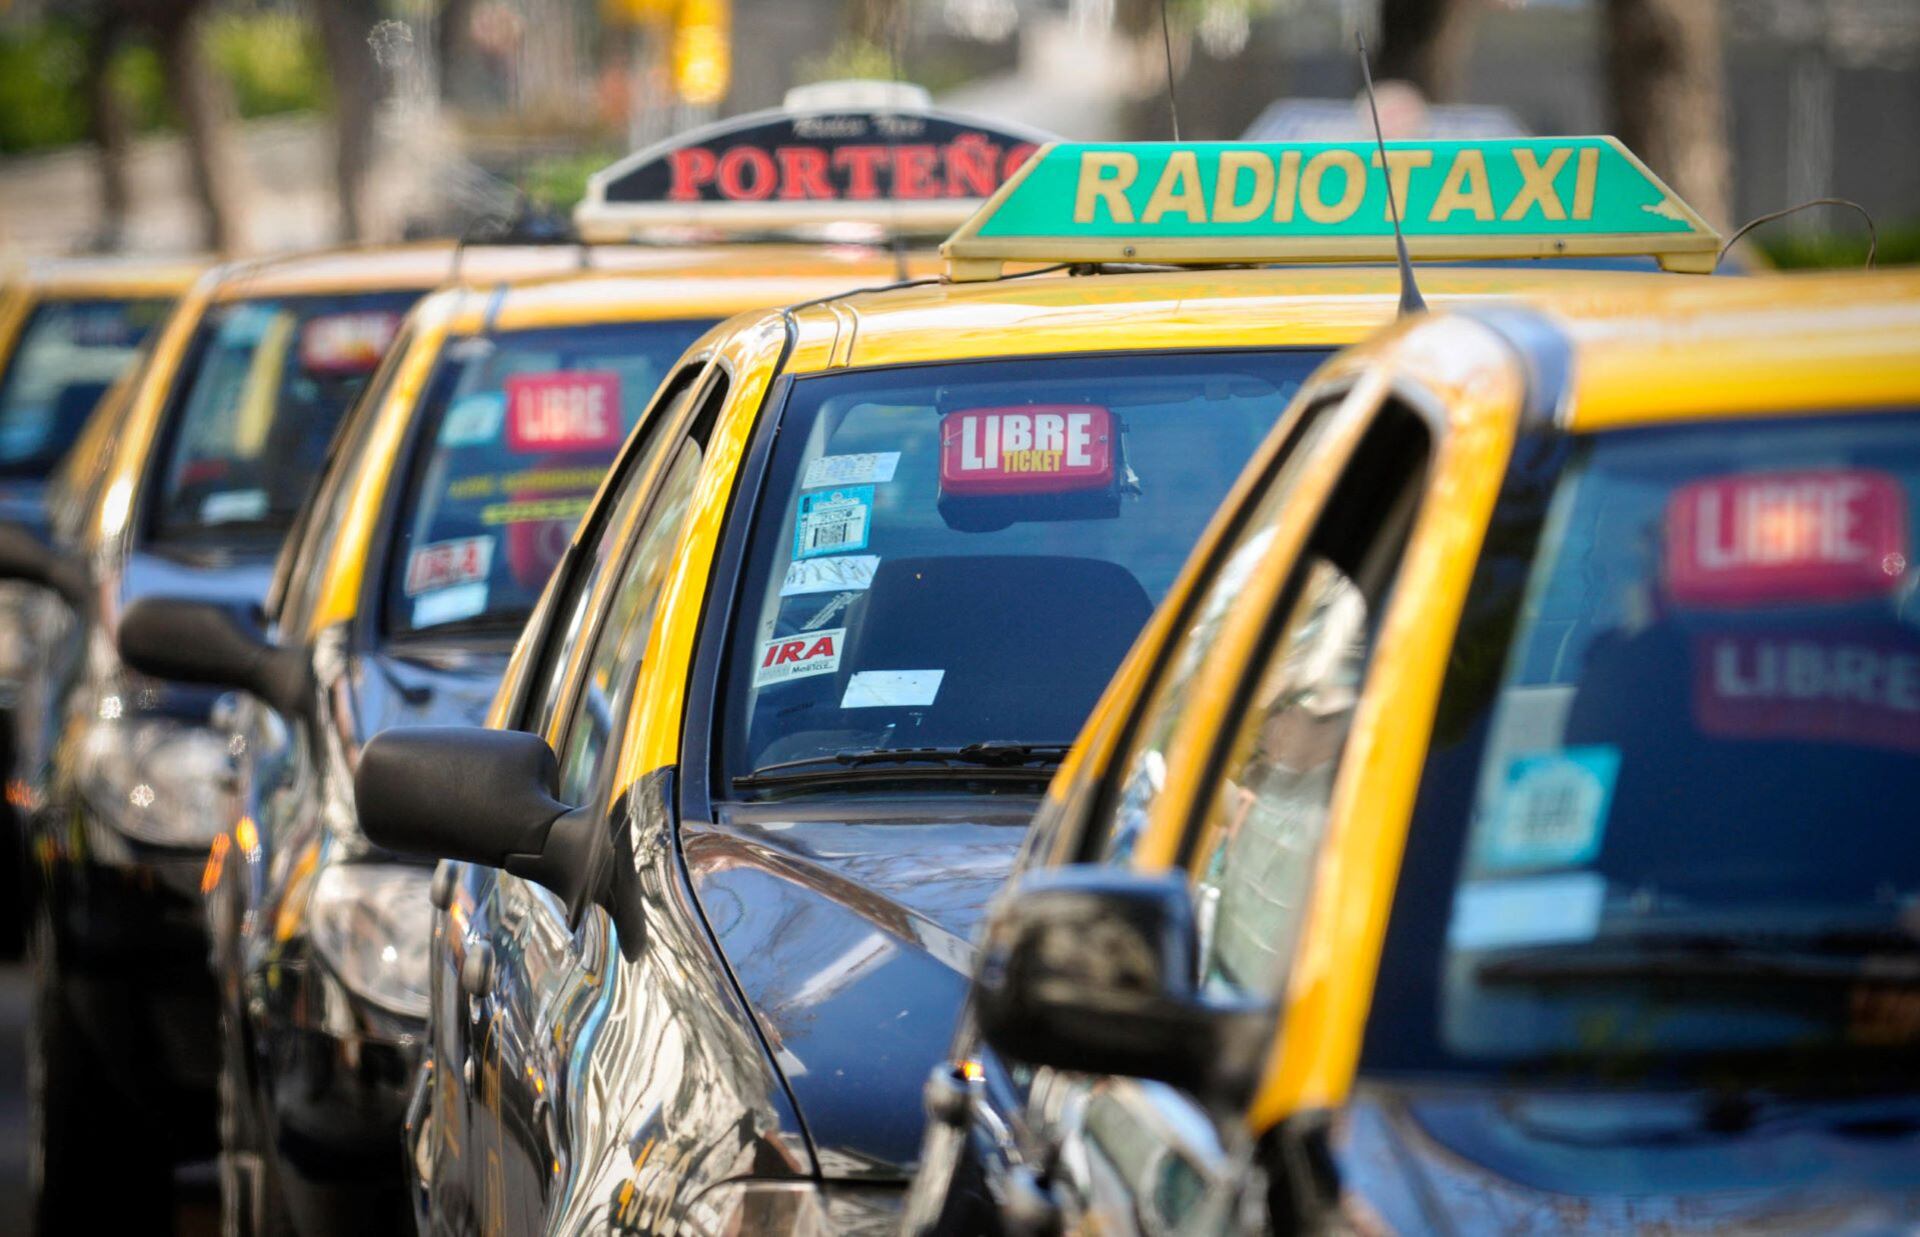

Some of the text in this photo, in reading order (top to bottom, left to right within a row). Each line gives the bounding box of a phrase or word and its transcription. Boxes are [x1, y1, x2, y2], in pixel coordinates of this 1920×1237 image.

[517, 383, 608, 443] LIBRE
[961, 413, 1091, 470] LIBRE
[1002, 449, 1064, 474] TICKET
[762, 636, 835, 668] IRA
